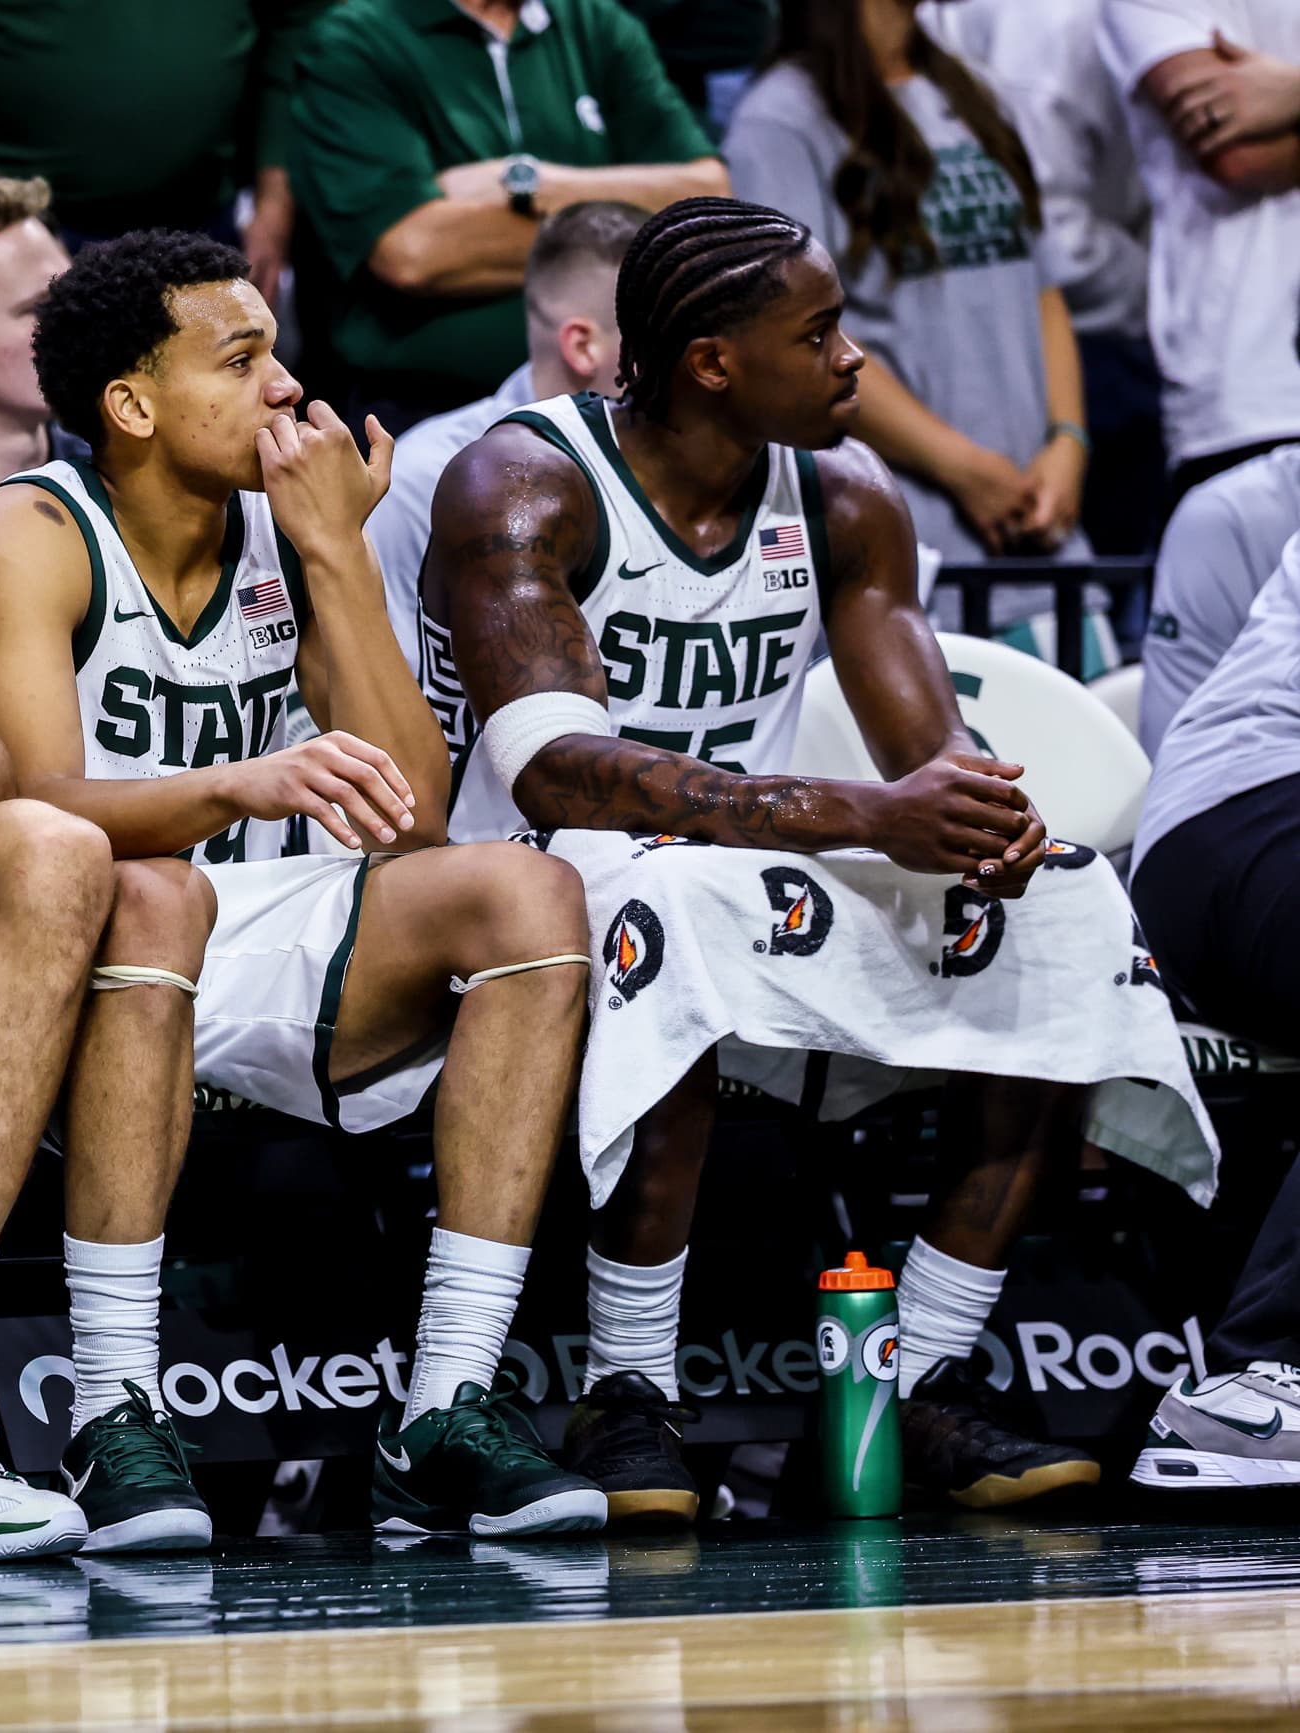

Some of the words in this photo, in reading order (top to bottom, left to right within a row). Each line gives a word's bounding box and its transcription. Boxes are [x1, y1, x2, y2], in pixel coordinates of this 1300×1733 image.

[598, 607, 809, 709] STATE
[161, 1337, 412, 1418] ocket
[1016, 1315, 1209, 1392] Roc
